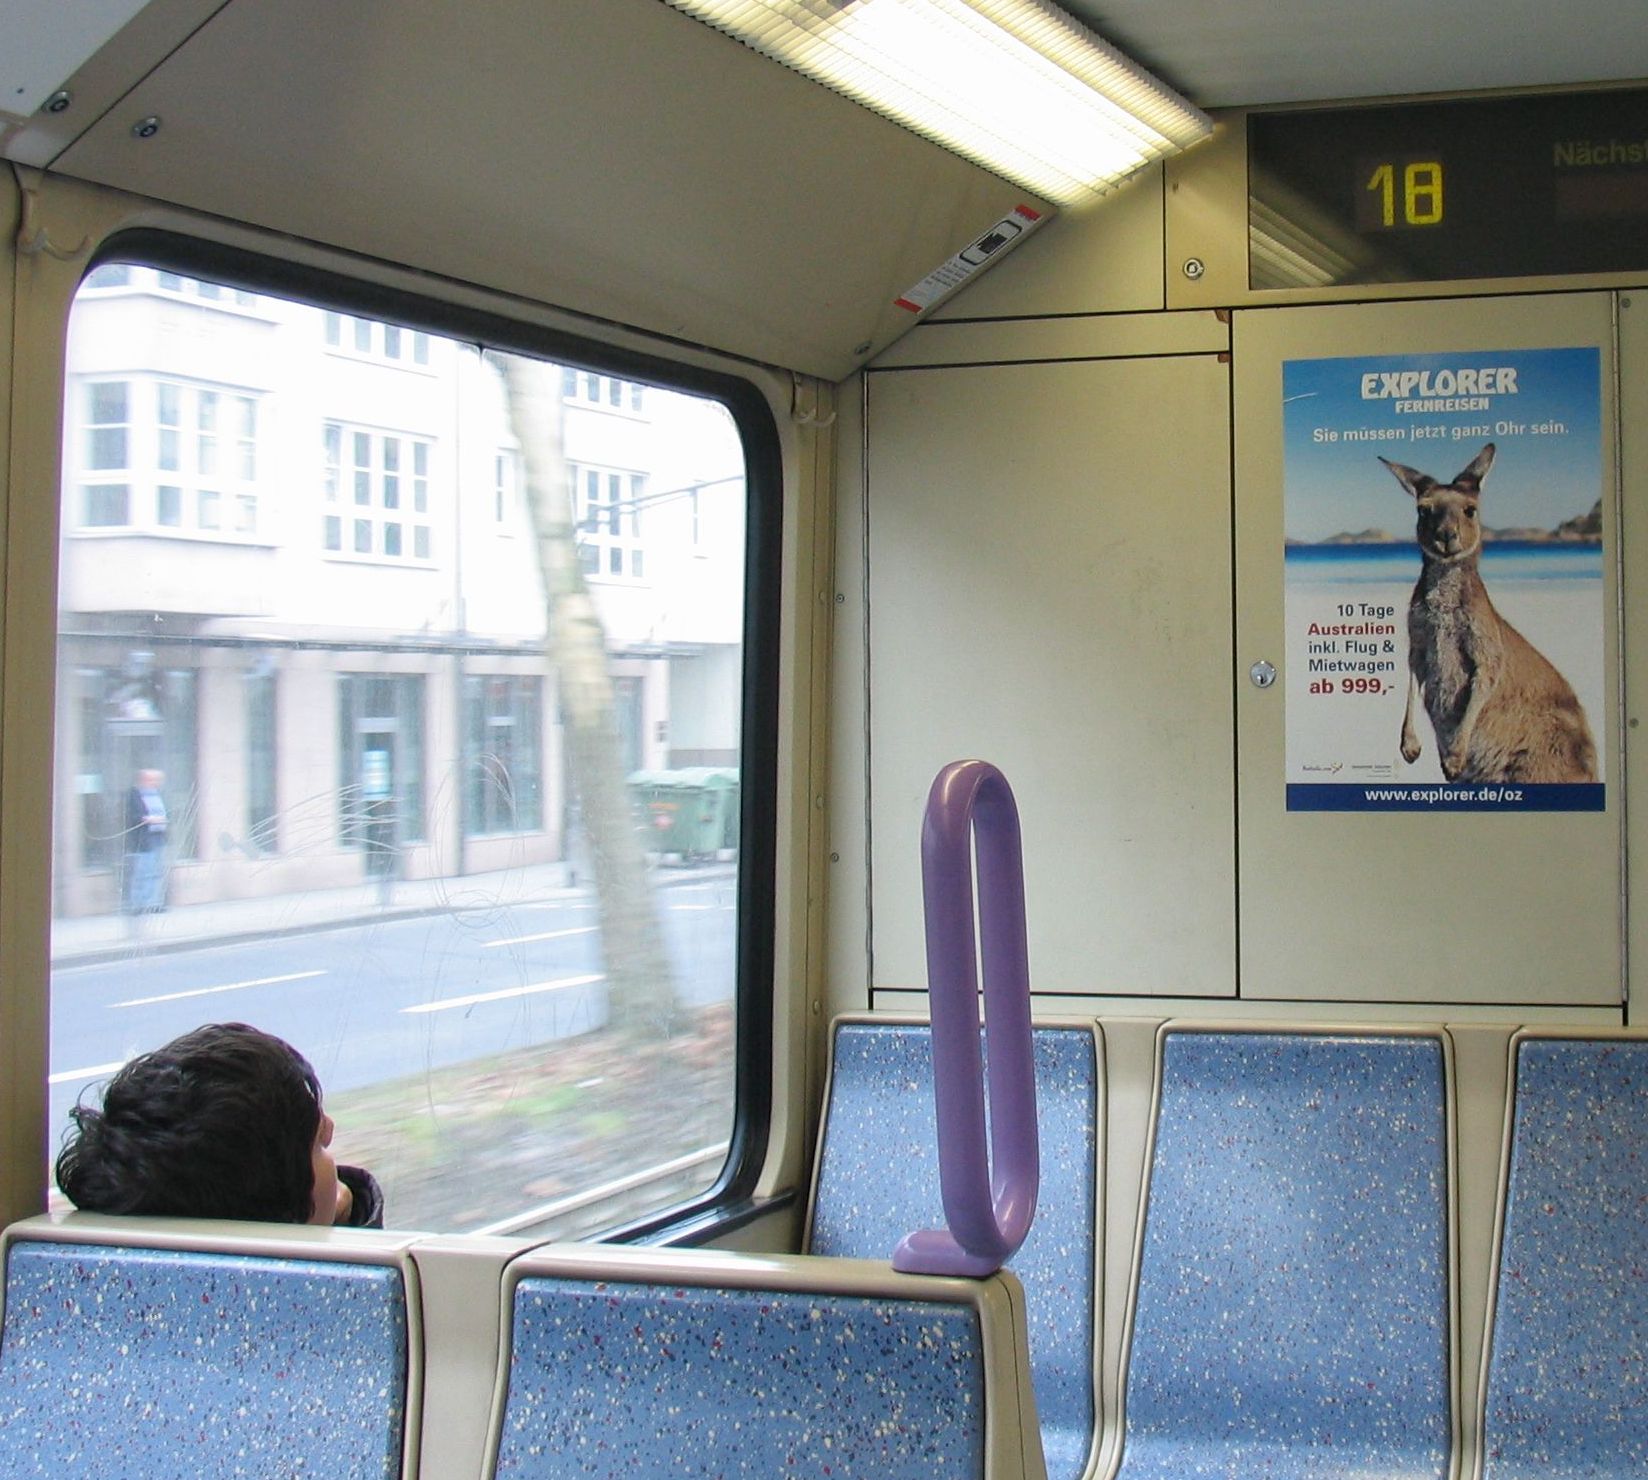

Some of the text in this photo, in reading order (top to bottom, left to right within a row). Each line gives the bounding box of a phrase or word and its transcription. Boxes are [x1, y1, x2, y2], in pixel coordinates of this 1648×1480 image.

[1367, 162, 1444, 227] 18
[1361, 367, 1519, 400] EXPLORER
[1395, 398, 1490, 414] FERNREISEN
[1313, 420, 1570, 443] Sie müssen jetzt ganz Ohr sein.
[1337, 603, 1395, 619] 10 Tage
[1308, 622, 1395, 636] Australien
[1308, 639, 1395, 656] inkl. Flug &
[1308, 658, 1395, 674] Mietwagen
[1309, 679, 1395, 696] ab 999,-
[1365, 787, 1523, 804] www.explorer.de/oz
